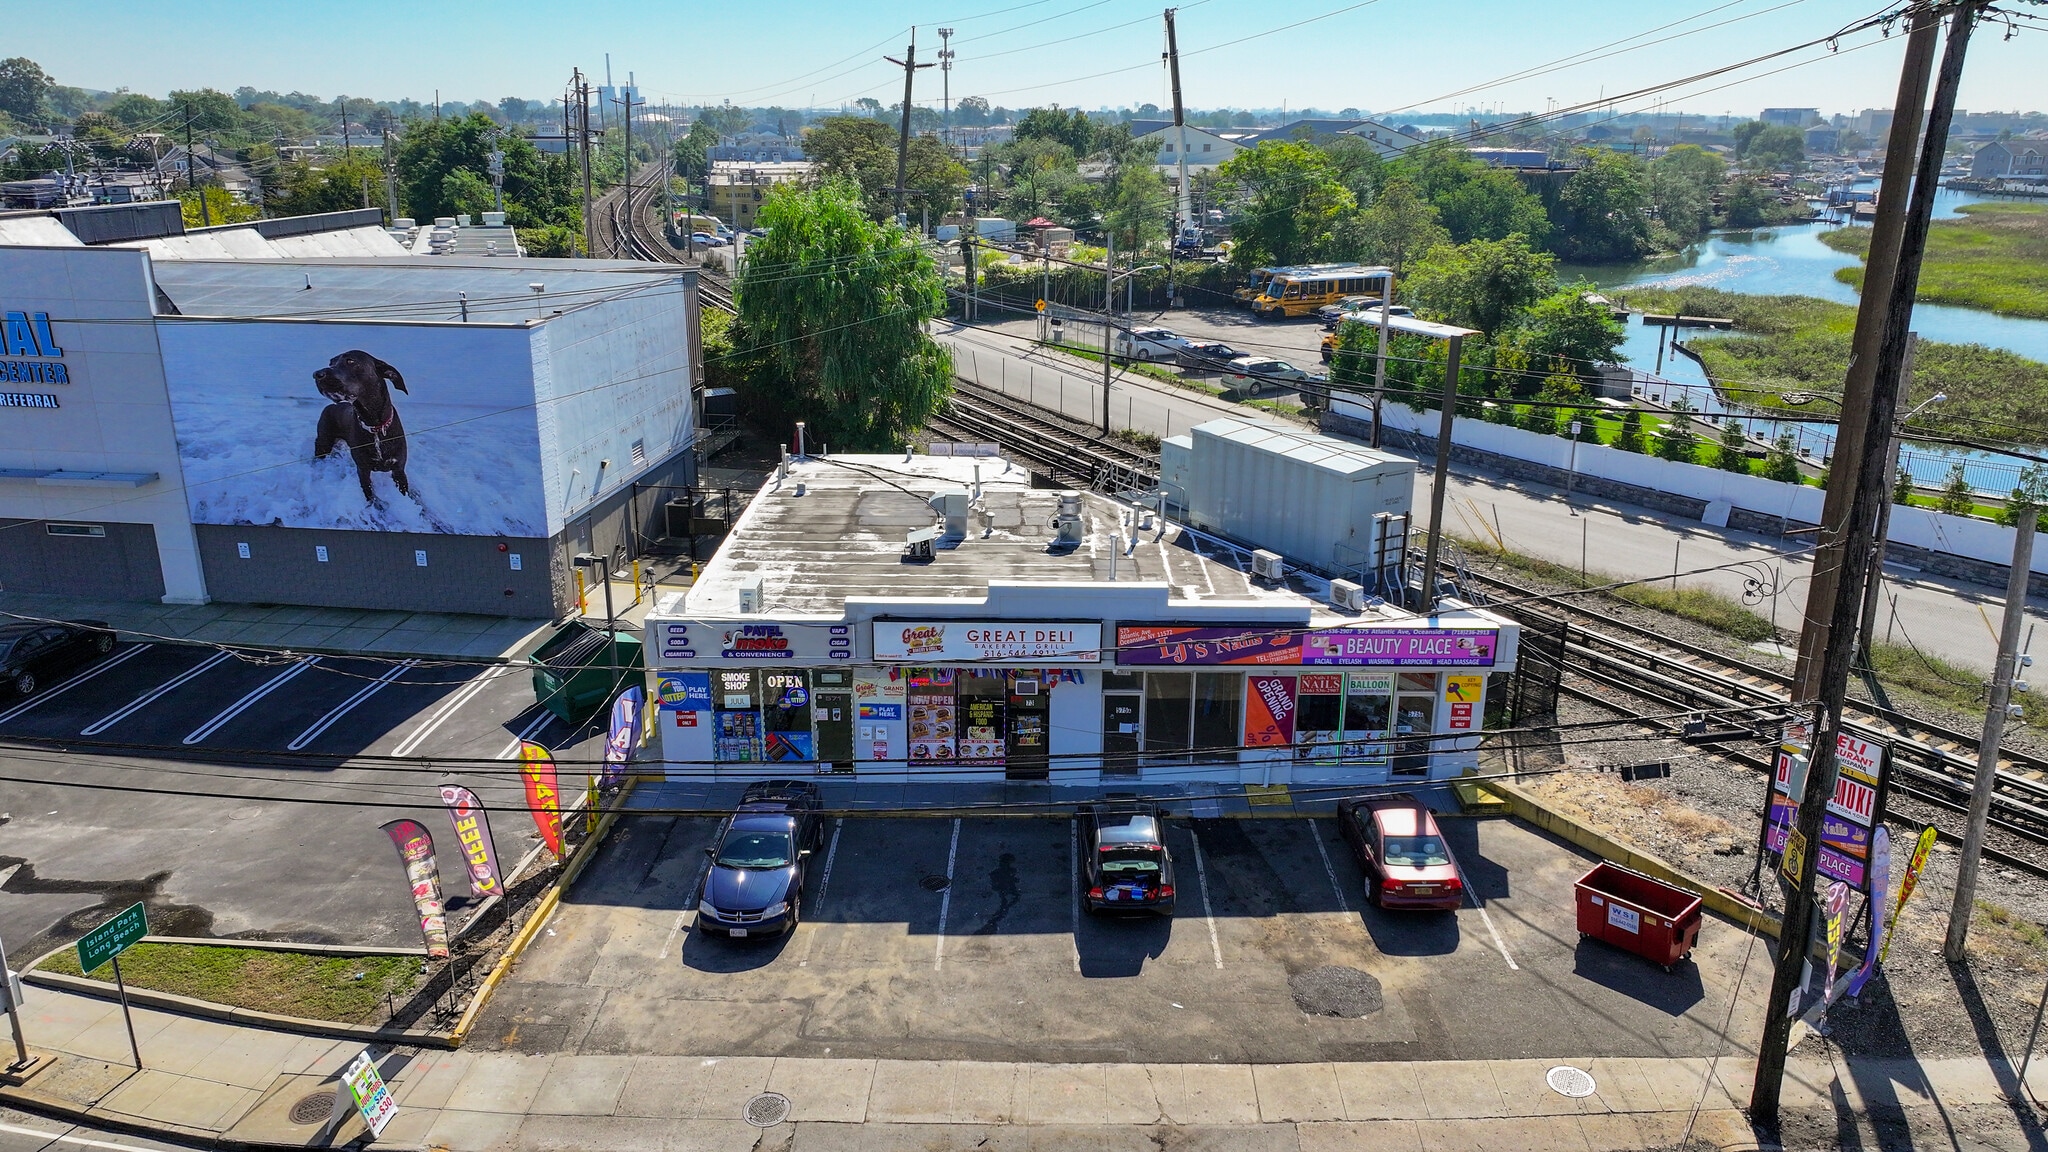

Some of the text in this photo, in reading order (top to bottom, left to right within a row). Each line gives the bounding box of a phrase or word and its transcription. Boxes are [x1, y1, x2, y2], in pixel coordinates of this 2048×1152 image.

[743, 626, 783, 637] PATEL
[902, 627, 938, 644] Great
[967, 630, 1072, 642] GREAT DELI
[1120, 637, 1146, 645] Oceanside
[1346, 638, 1452, 655] BEAUTY PLACE
[721, 673, 750, 682] SMOKE
[724, 682, 748, 690] SHOP
[768, 676, 802, 688] OPEN
[1302, 680, 1340, 688] NAILS
[911, 696, 953, 704] NOW OPEN
[1257, 680, 1287, 721] OPENING
[1269, 679, 1294, 711] GRAND
[1837, 734, 1867, 755] ELI
[1831, 778, 1873, 817] MOKE
[1820, 854, 1851, 876] PLACE
[86, 911, 138, 948] Island Park
[88, 922, 140, 958] Long Beach
[364, 1108, 370, 1116] 1
[374, 1087, 387, 1104] $20
[370, 1117, 376, 1127] 2
[378, 1096, 393, 1115] $30
